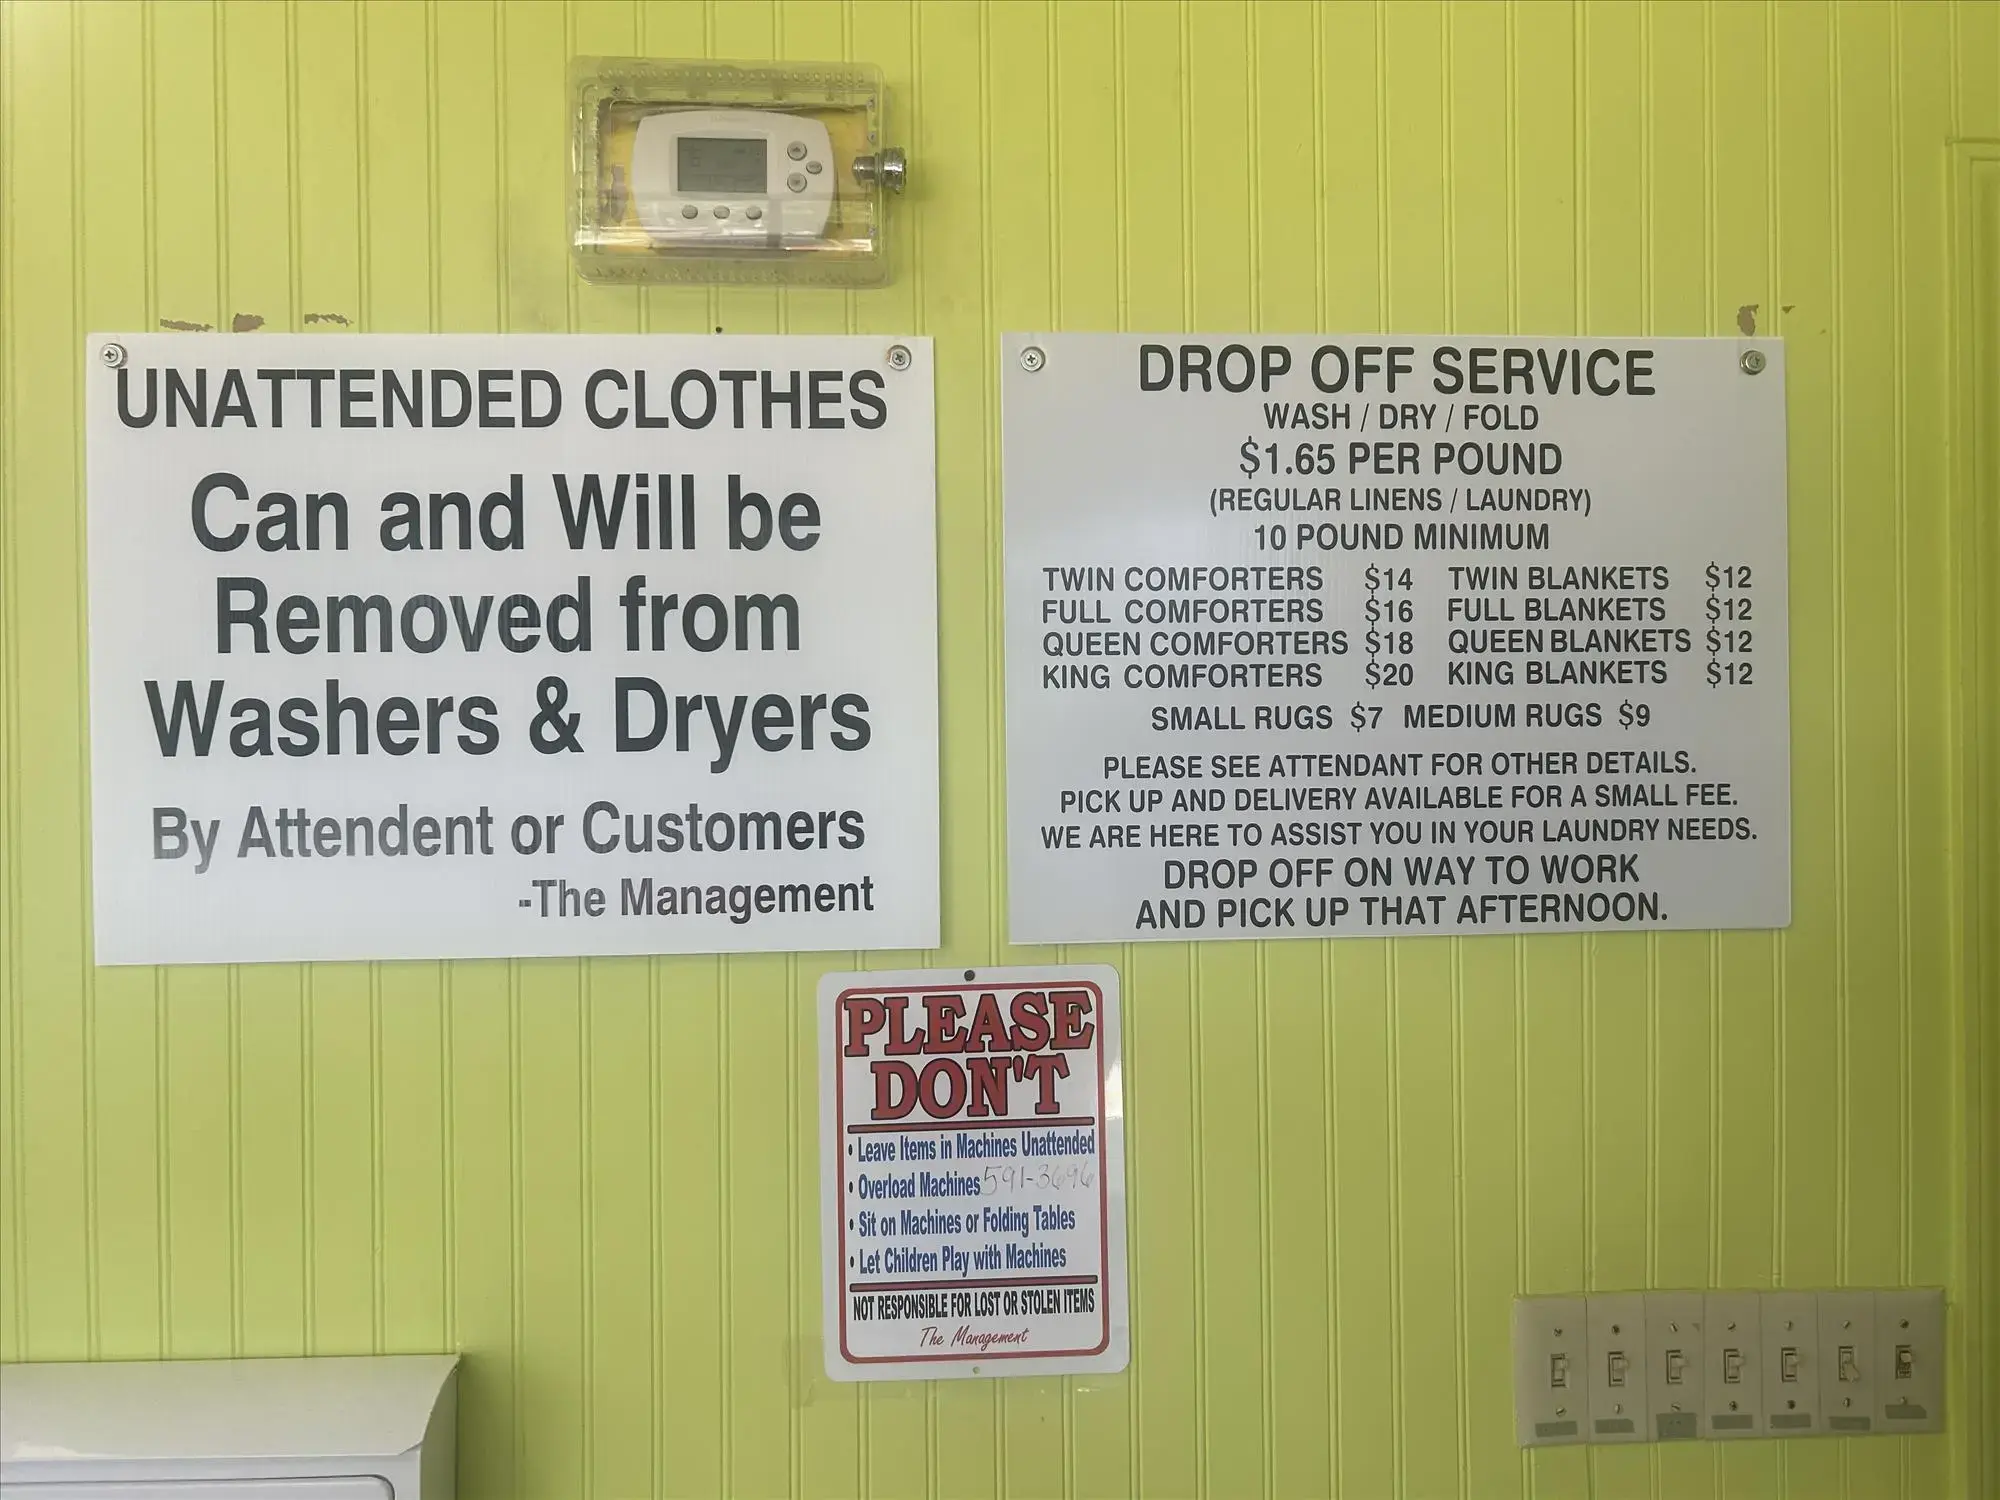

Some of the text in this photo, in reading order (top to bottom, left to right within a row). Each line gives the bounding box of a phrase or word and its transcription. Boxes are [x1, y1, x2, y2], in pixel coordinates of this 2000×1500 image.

[1140, 344, 1655, 396] DROP OFF SERVICE
[116, 367, 887, 429] UNATTENDED CLOTHES
[1264, 403, 1350, 429] WASH
[1380, 404, 1436, 429] DRY
[1465, 404, 1538, 430] FOLD
[1240, 436, 1562, 479] $1.65 PER POUND
[192, 473, 820, 552] Can and Will be
[1211, 488, 1340, 517] (REGULAR
[1351, 488, 1442, 511] LINENS
[1467, 488, 1591, 517] LAUNDRY)
[1255, 523, 1548, 550] 10 POUND MINIMUM
[1043, 563, 1413, 594] TWIN COMFORTERS $14
[1448, 561, 1751, 592] TWIN BLANKETS $12
[217, 575, 799, 654] Removed from
[1043, 595, 1413, 626] FULL COMFORTERS $16
[1448, 593, 1752, 624] FULL BLANKETS $12
[1043, 628, 1413, 658] QUEEN COMFORTERS $18
[1449, 626, 1752, 656] QUEEN BLANKETS $12
[1043, 660, 1413, 691] KING COMFORTERS $20
[1449, 658, 1752, 688] KING BLANKETS $12
[144, 676, 871, 773] Washers & Dryers
[1152, 699, 1650, 732] SMALL RUGS $7 MEDIUM RUGS $9
[1105, 751, 1696, 779] PLEASE SEE ATTENDANT FOR OTHER DETAILS.
[1061, 784, 1737, 813] PICK UP AND DELIVERY AVAILABLE FOR A SMALL FEE.
[153, 801, 865, 874] By Attendent or Customers
[1041, 817, 1757, 849] WE ARE HERE TO ASSIST YOU IN YOUR LAUNDRY NEEDS.
[1165, 854, 1639, 889] DROP OFF ON WAY TO WORK
[519, 876, 874, 924] -The Management
[1136, 892, 1667, 929] AND PICK UP THAT AFTERNOON.
[844, 991, 1094, 1057] PLEASE
[870, 1053, 1070, 1120] DON'T
[858, 1129, 1094, 1162] Leave Items in Machines Unattended
[859, 1171, 980, 1199] Overload Machines
[859, 1205, 1075, 1238] Sit on Machines or Folding Tables
[860, 1242, 1066, 1277] Let Children Play with Machines
[854, 1288, 1094, 1320] NOT RESPONSIBLE FOR LOST OR STOLEN ITEMS
[921, 1325, 1029, 1351] The Management
